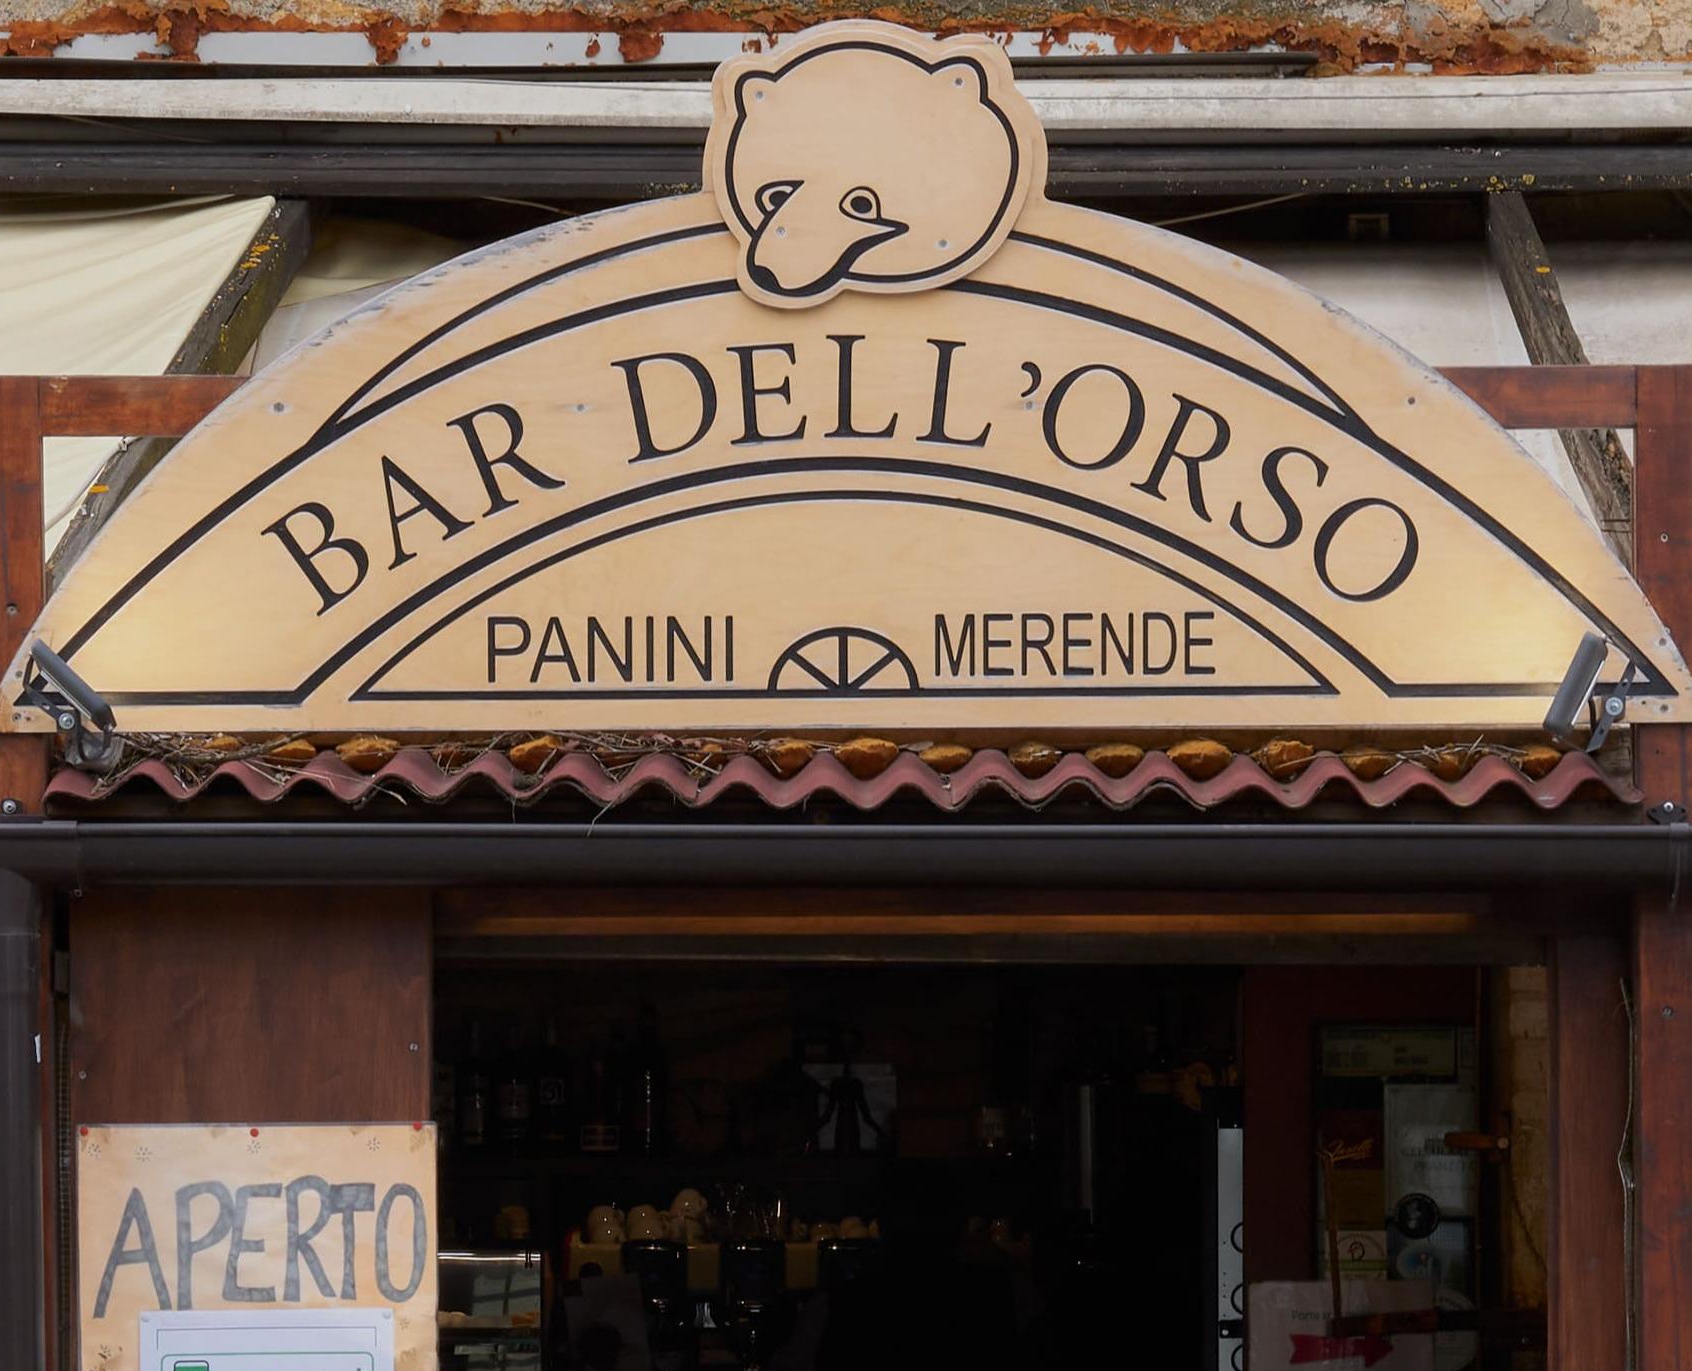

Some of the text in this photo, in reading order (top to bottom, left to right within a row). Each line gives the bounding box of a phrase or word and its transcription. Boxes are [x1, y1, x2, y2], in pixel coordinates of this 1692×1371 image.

[261, 403, 566, 616] BAR
[486, 616, 734, 683] PANINI
[935, 611, 1215, 679] MERENDE
[93, 1175, 427, 1319] APERTO
